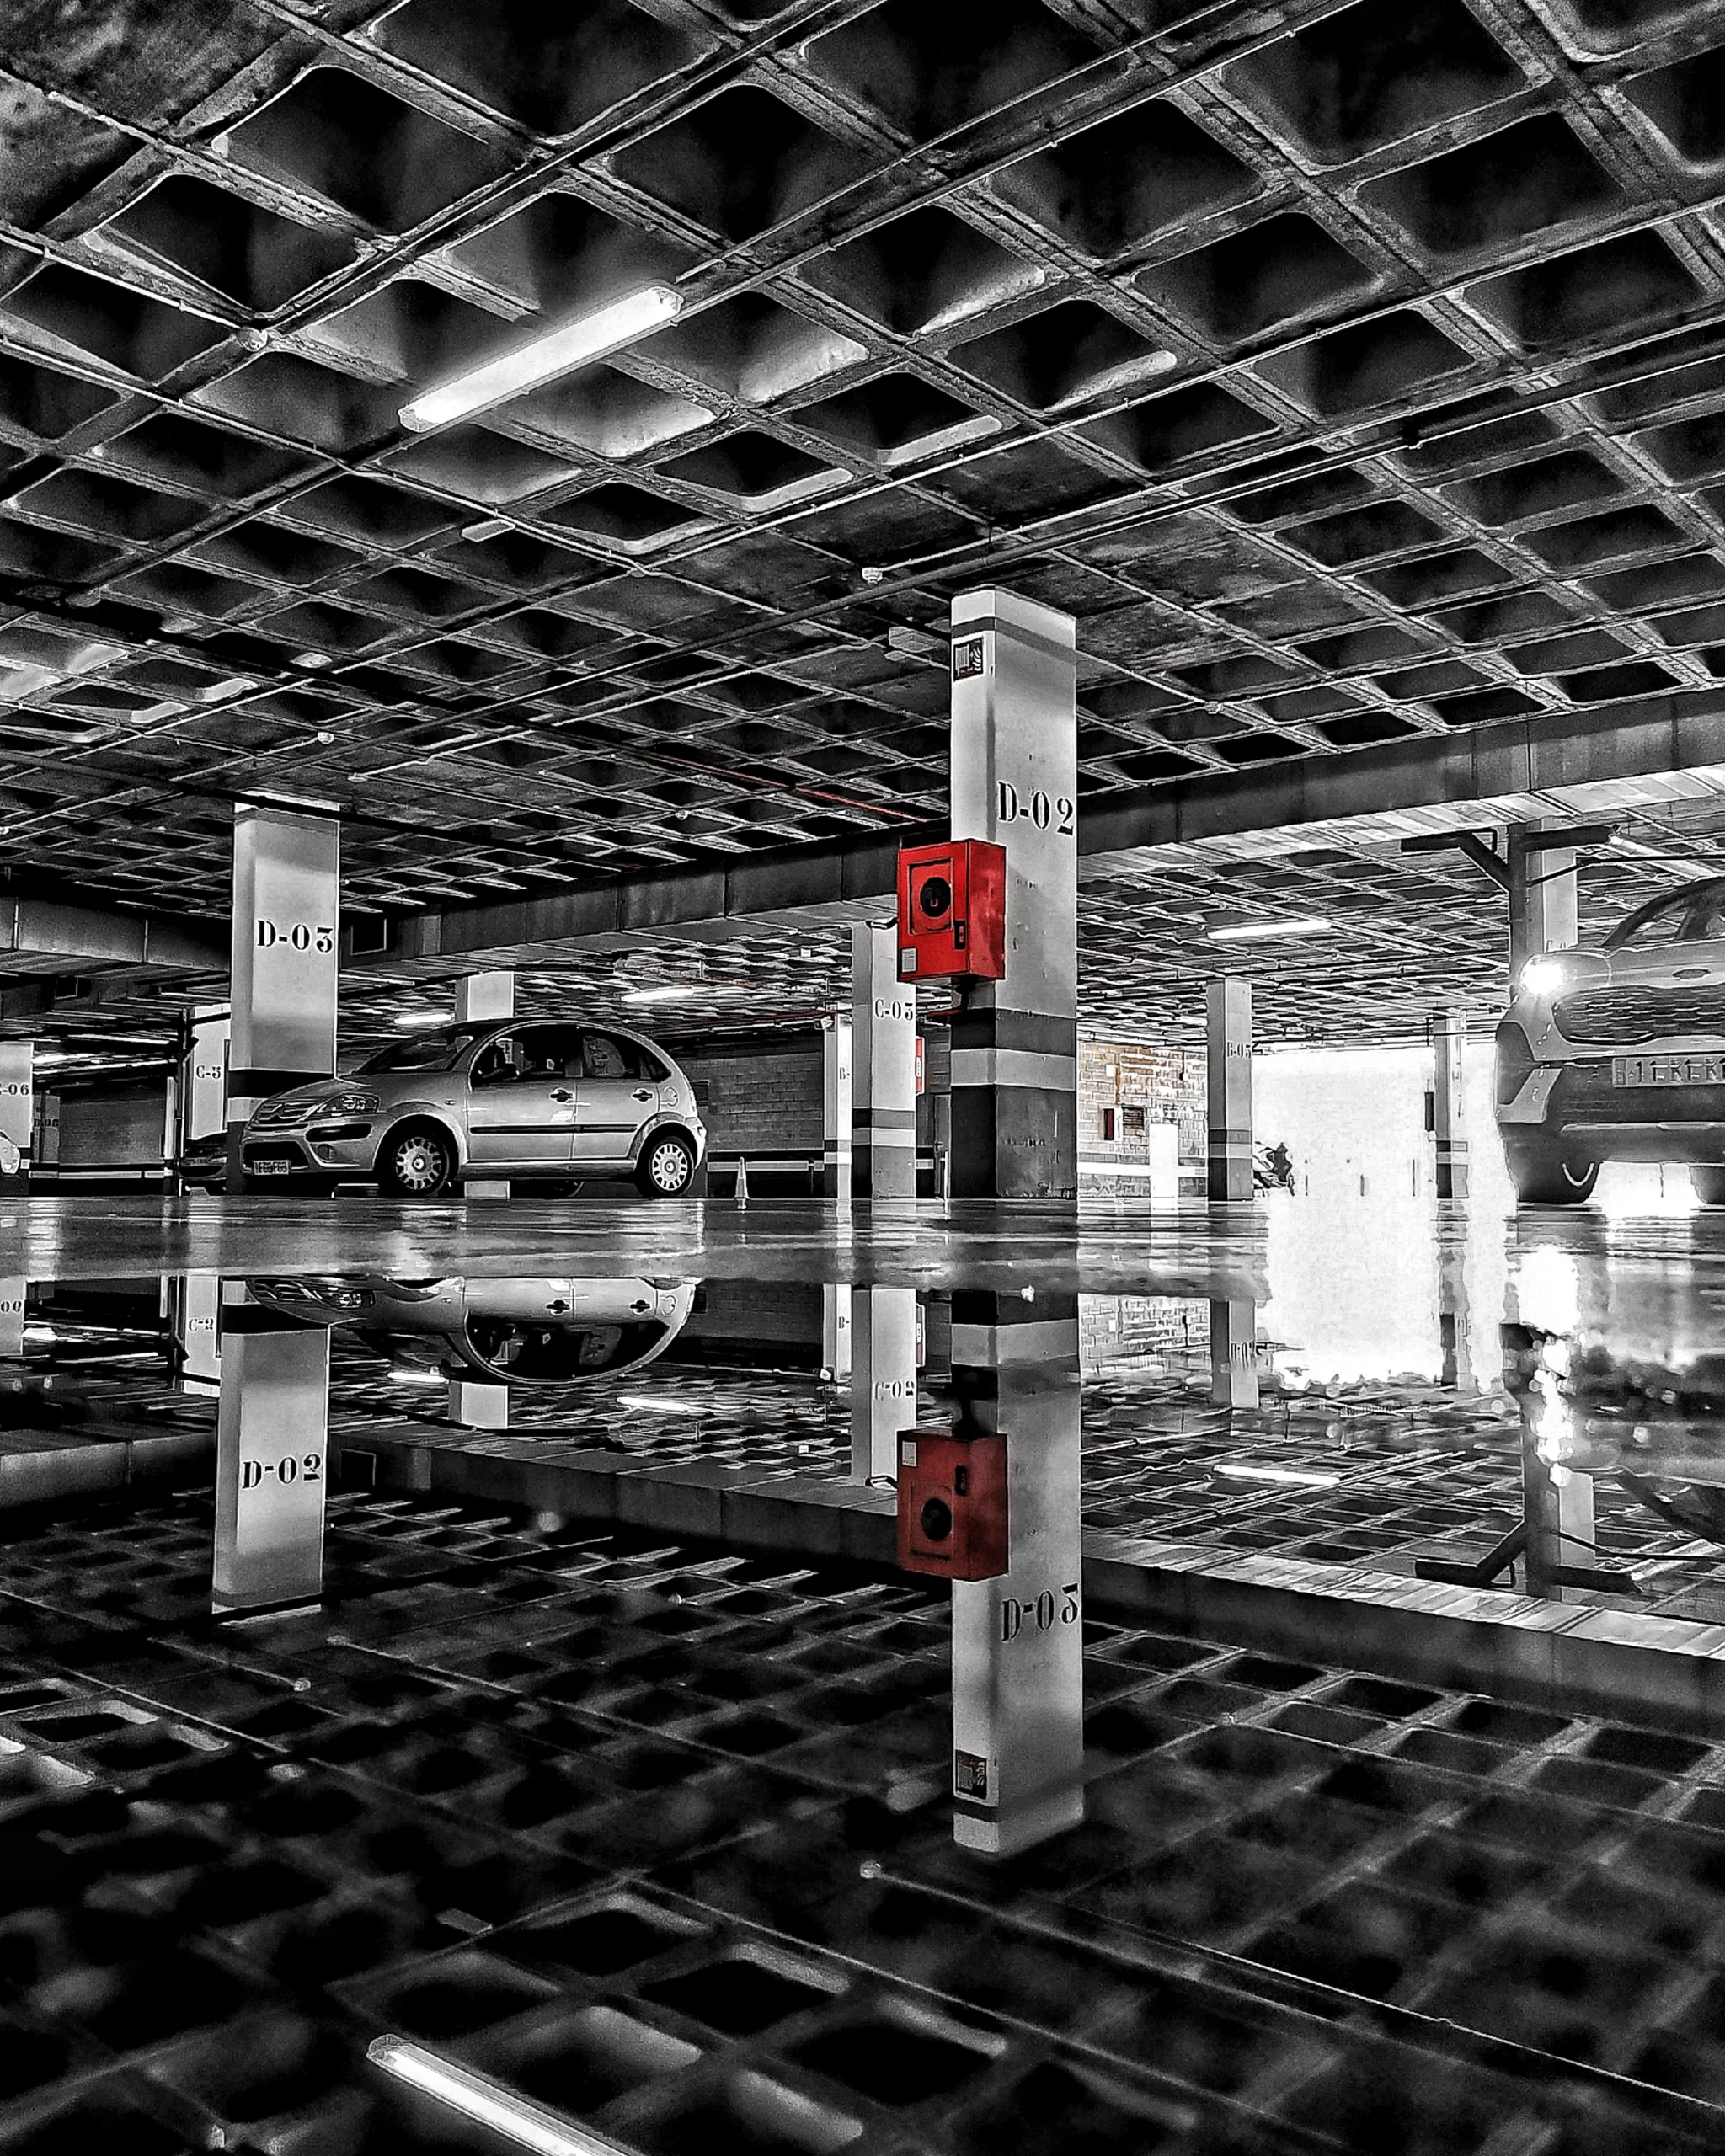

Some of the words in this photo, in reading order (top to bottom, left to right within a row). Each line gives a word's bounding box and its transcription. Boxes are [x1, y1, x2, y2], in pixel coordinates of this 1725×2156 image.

[998, 781, 1074, 836] D-02
[257, 919, 334, 953] D-03
[196, 1065, 222, 1079] C-5
